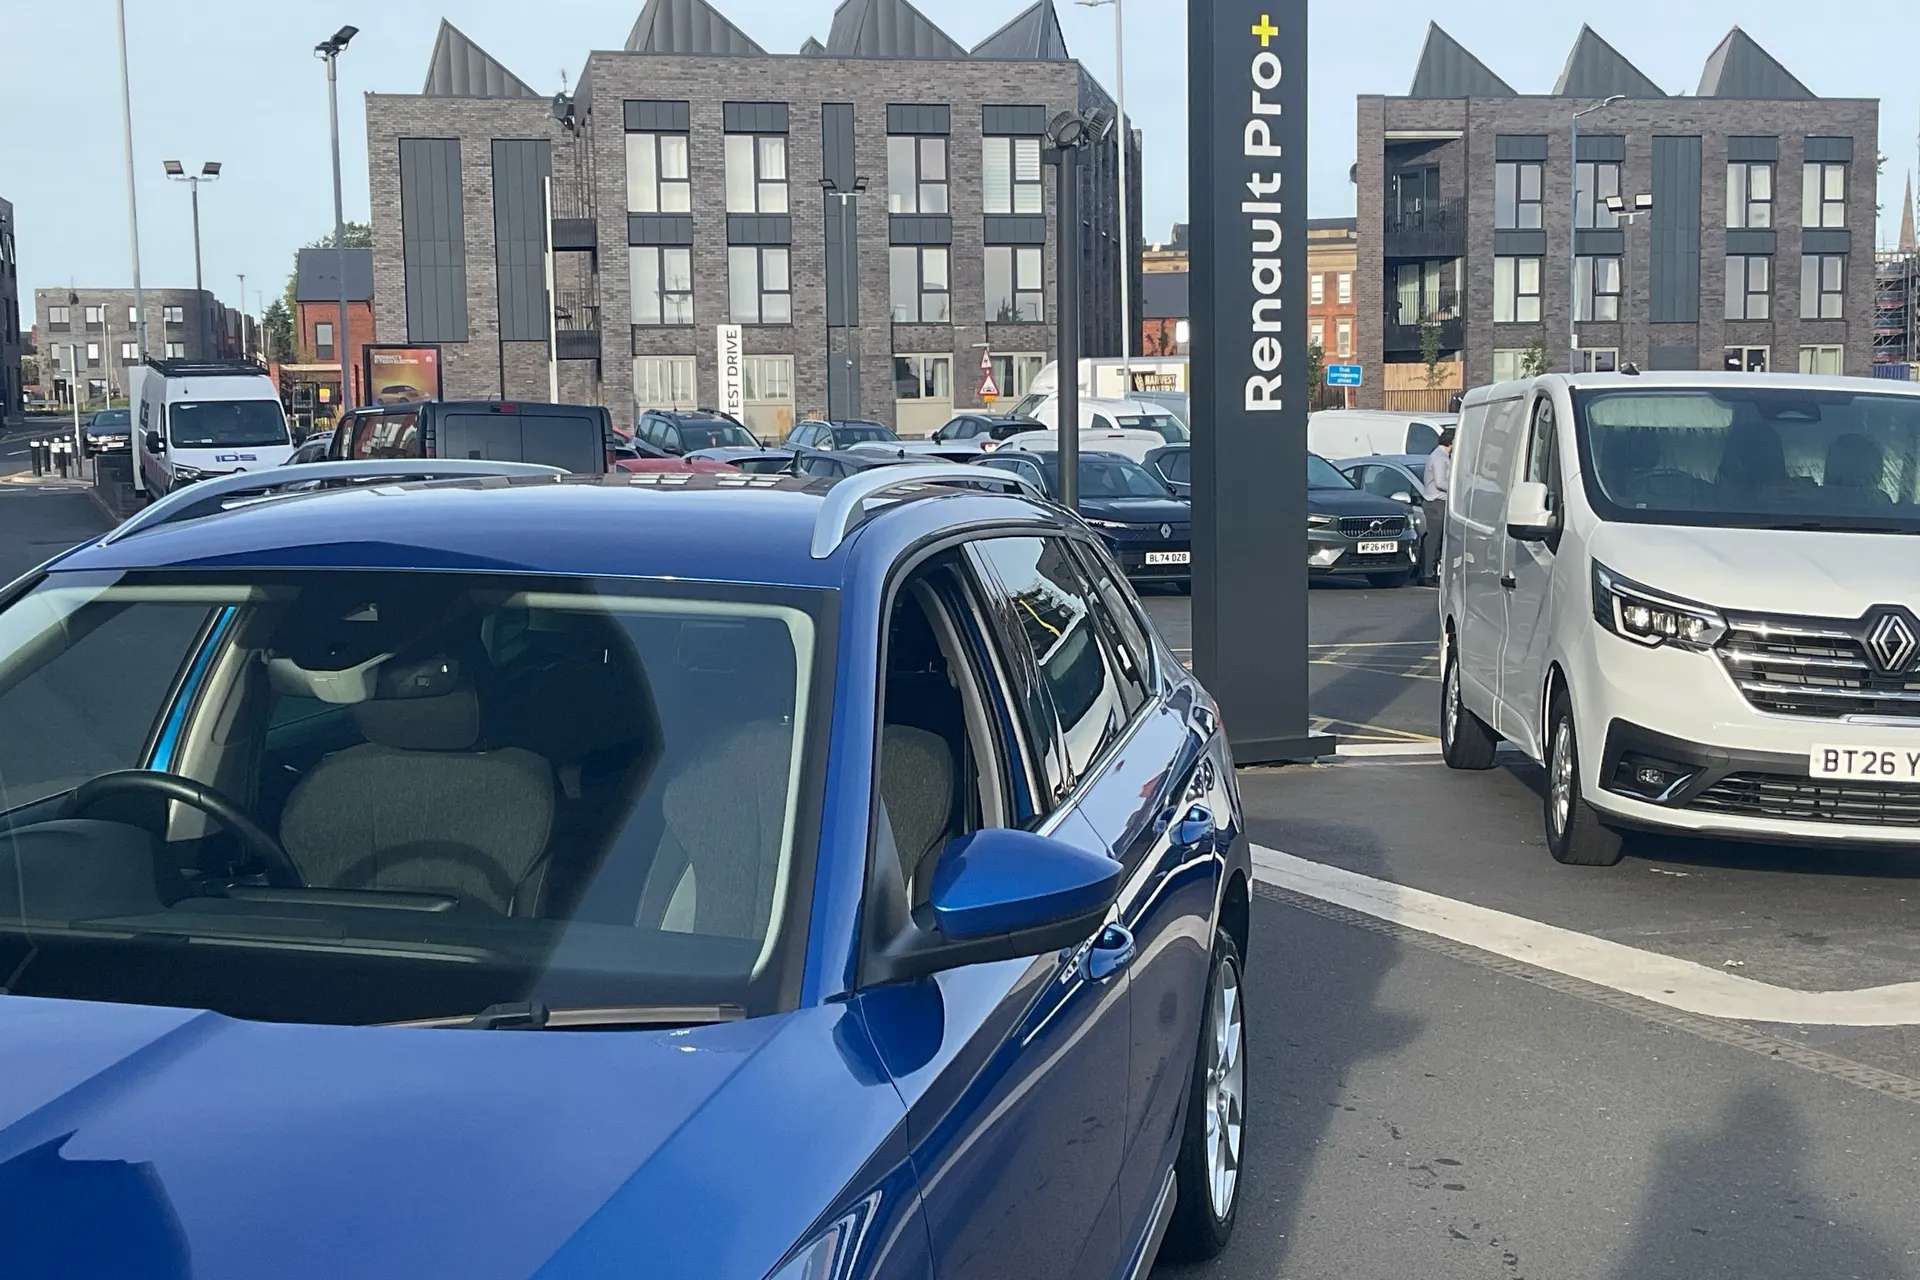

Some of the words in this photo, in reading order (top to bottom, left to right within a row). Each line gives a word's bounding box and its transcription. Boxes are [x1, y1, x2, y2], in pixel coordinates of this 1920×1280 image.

[1241, 172, 1283, 411] Renault
[726, 329, 738, 377] DRIVE
[1144, 374, 1177, 385] HARVEST
[727, 380, 739, 416] TEST
[215, 454, 257, 462] IDS
[1149, 553, 1170, 562] BL74
[1822, 748, 1897, 776] BT26
[1905, 751, 1920, 777] Y
